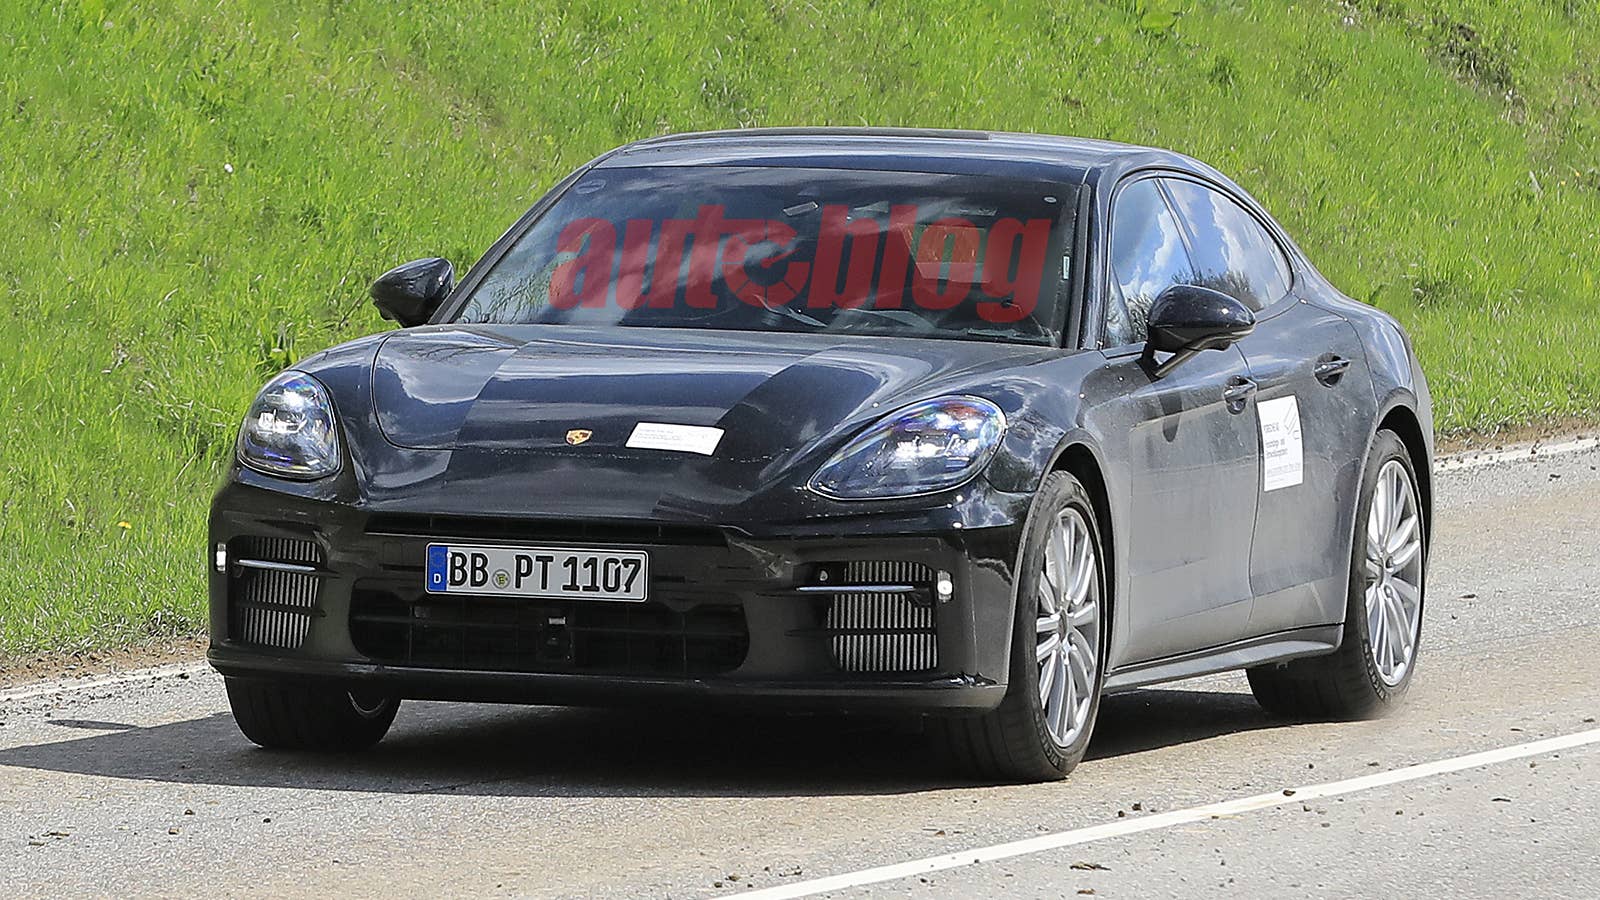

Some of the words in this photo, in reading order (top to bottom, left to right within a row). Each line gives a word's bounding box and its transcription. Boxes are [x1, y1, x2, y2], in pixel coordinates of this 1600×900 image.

[433, 573, 441, 584] D
[450, 551, 489, 588] BB
[515, 554, 554, 590] PT
[561, 556, 642, 593] 1107
